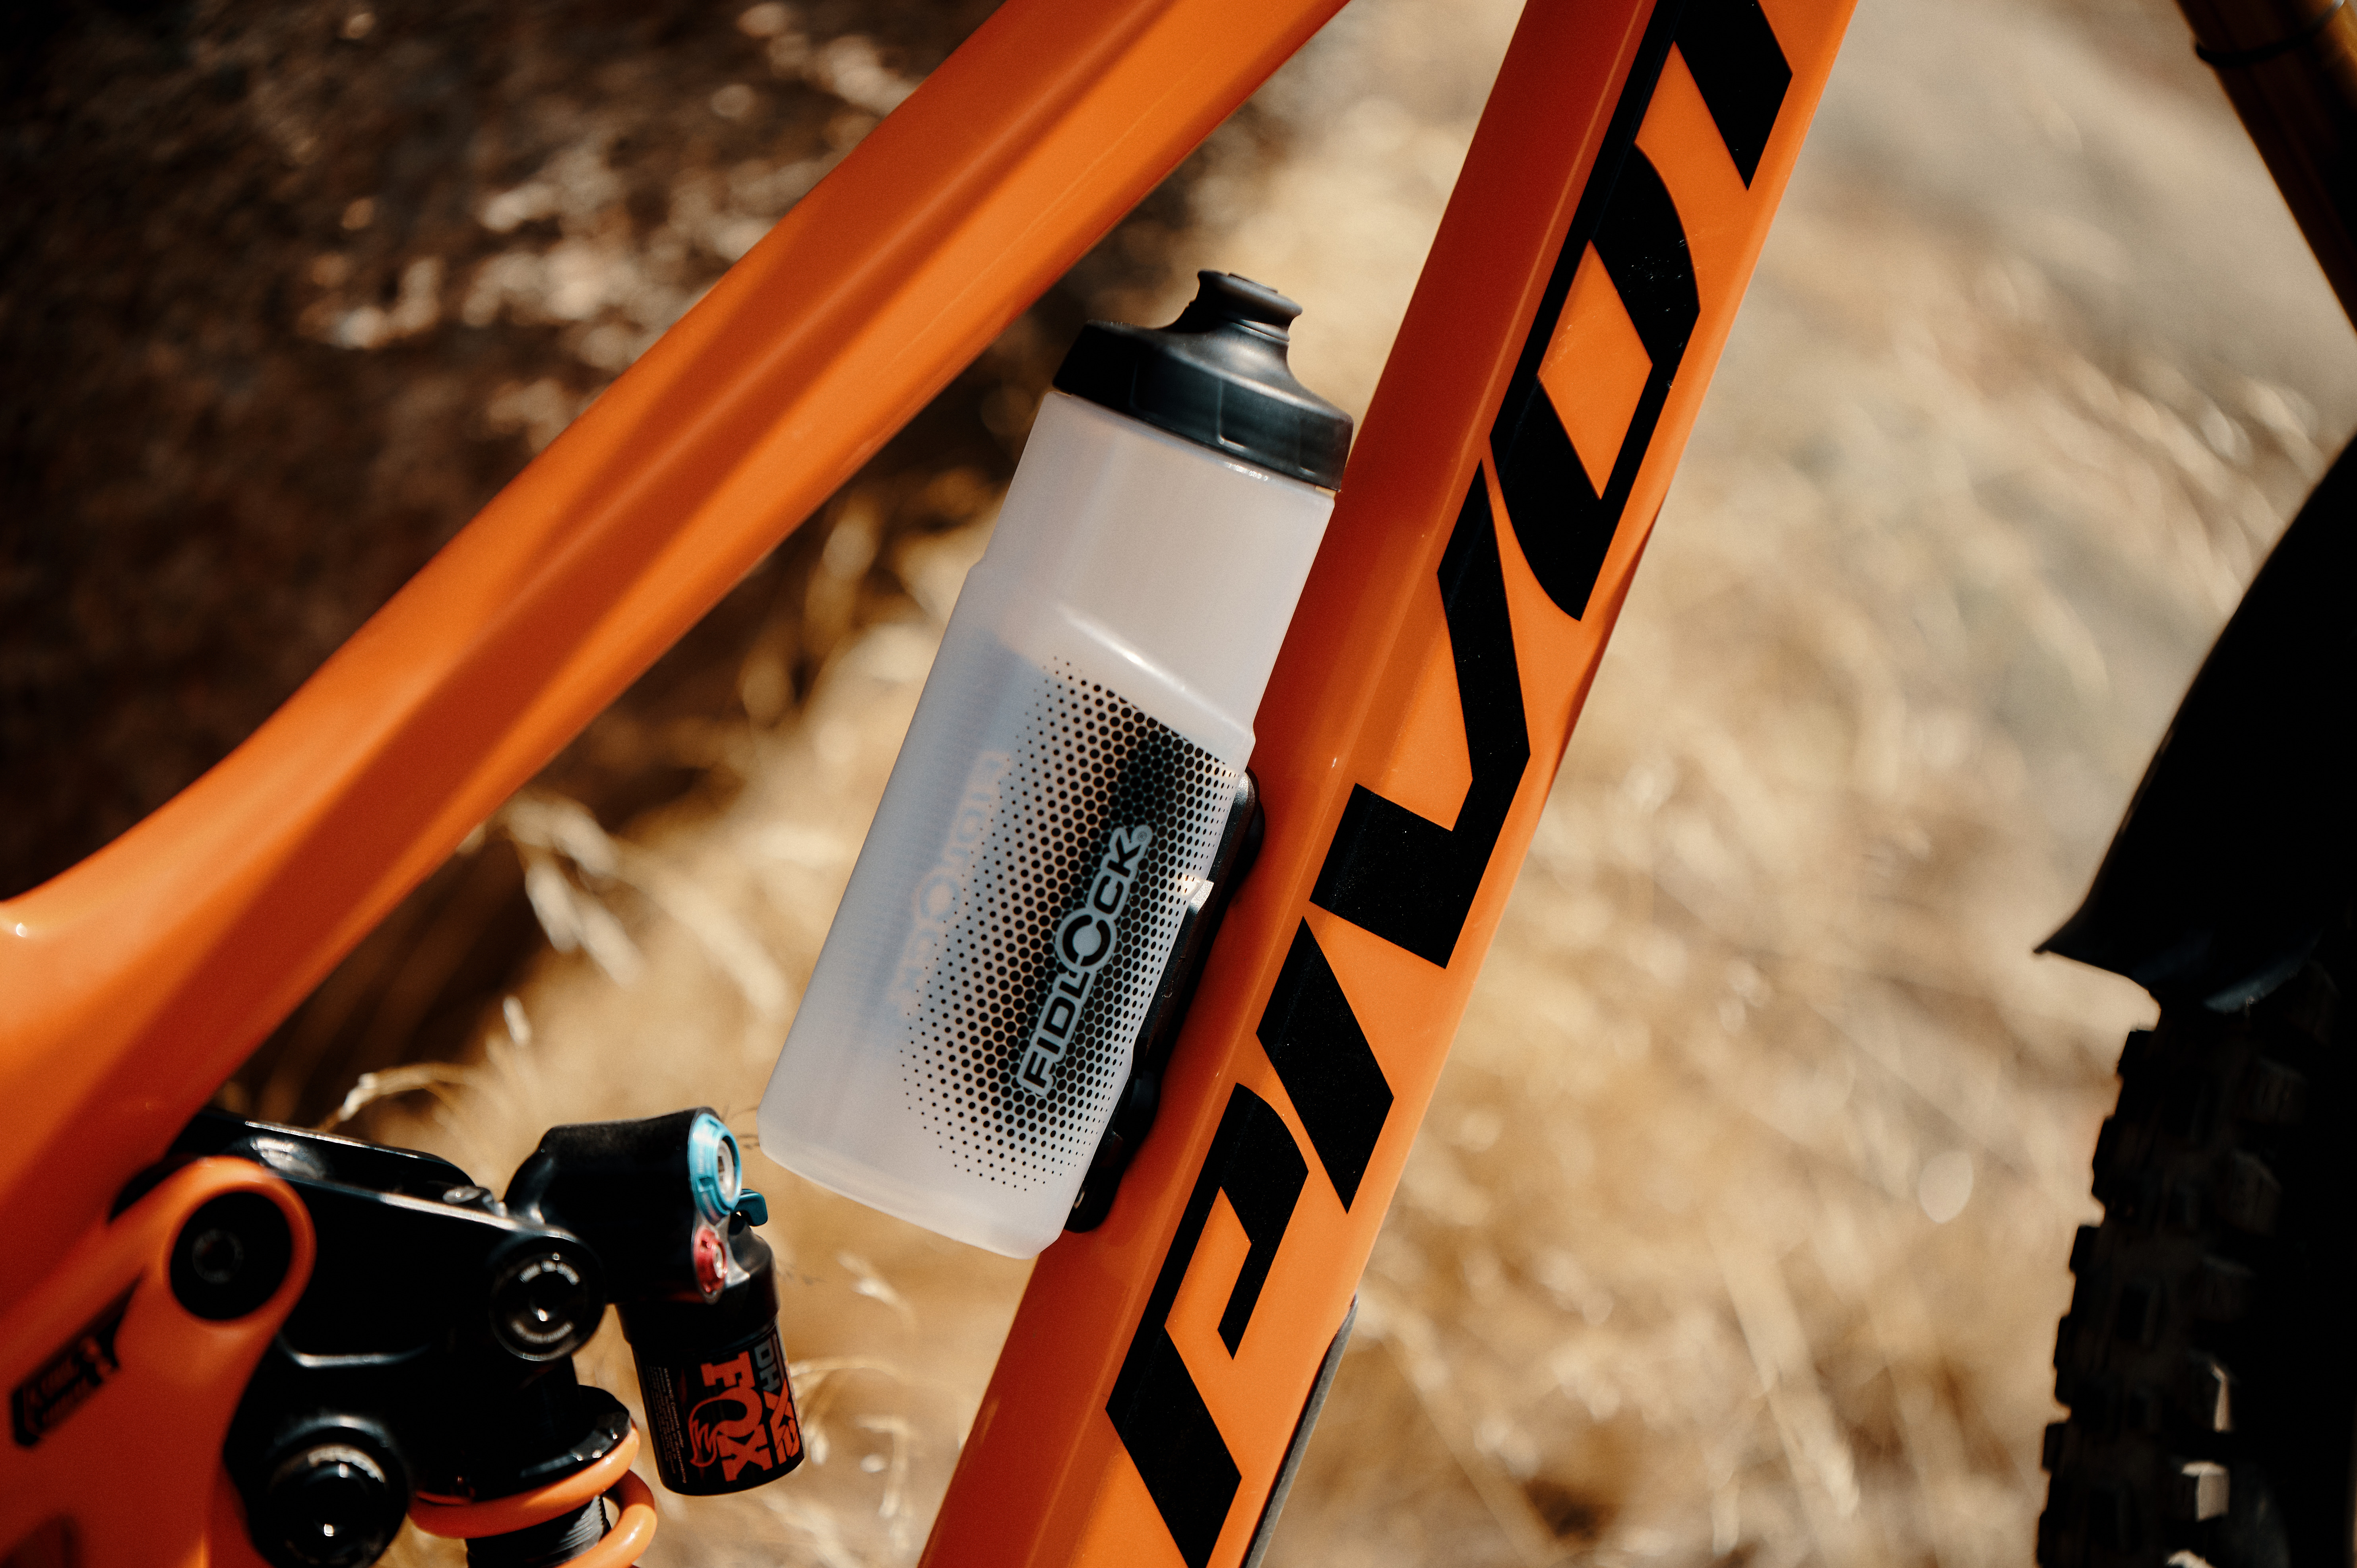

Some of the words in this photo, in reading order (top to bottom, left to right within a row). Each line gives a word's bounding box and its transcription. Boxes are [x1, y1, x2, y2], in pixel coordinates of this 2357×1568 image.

[1023, 836, 1141, 1088] FIDLOCK
[670, 1401, 681, 1429] Contents
[676, 1430, 685, 1449] under
[689, 1351, 773, 1482] FOX
[674, 1441, 688, 1484] disassembling
